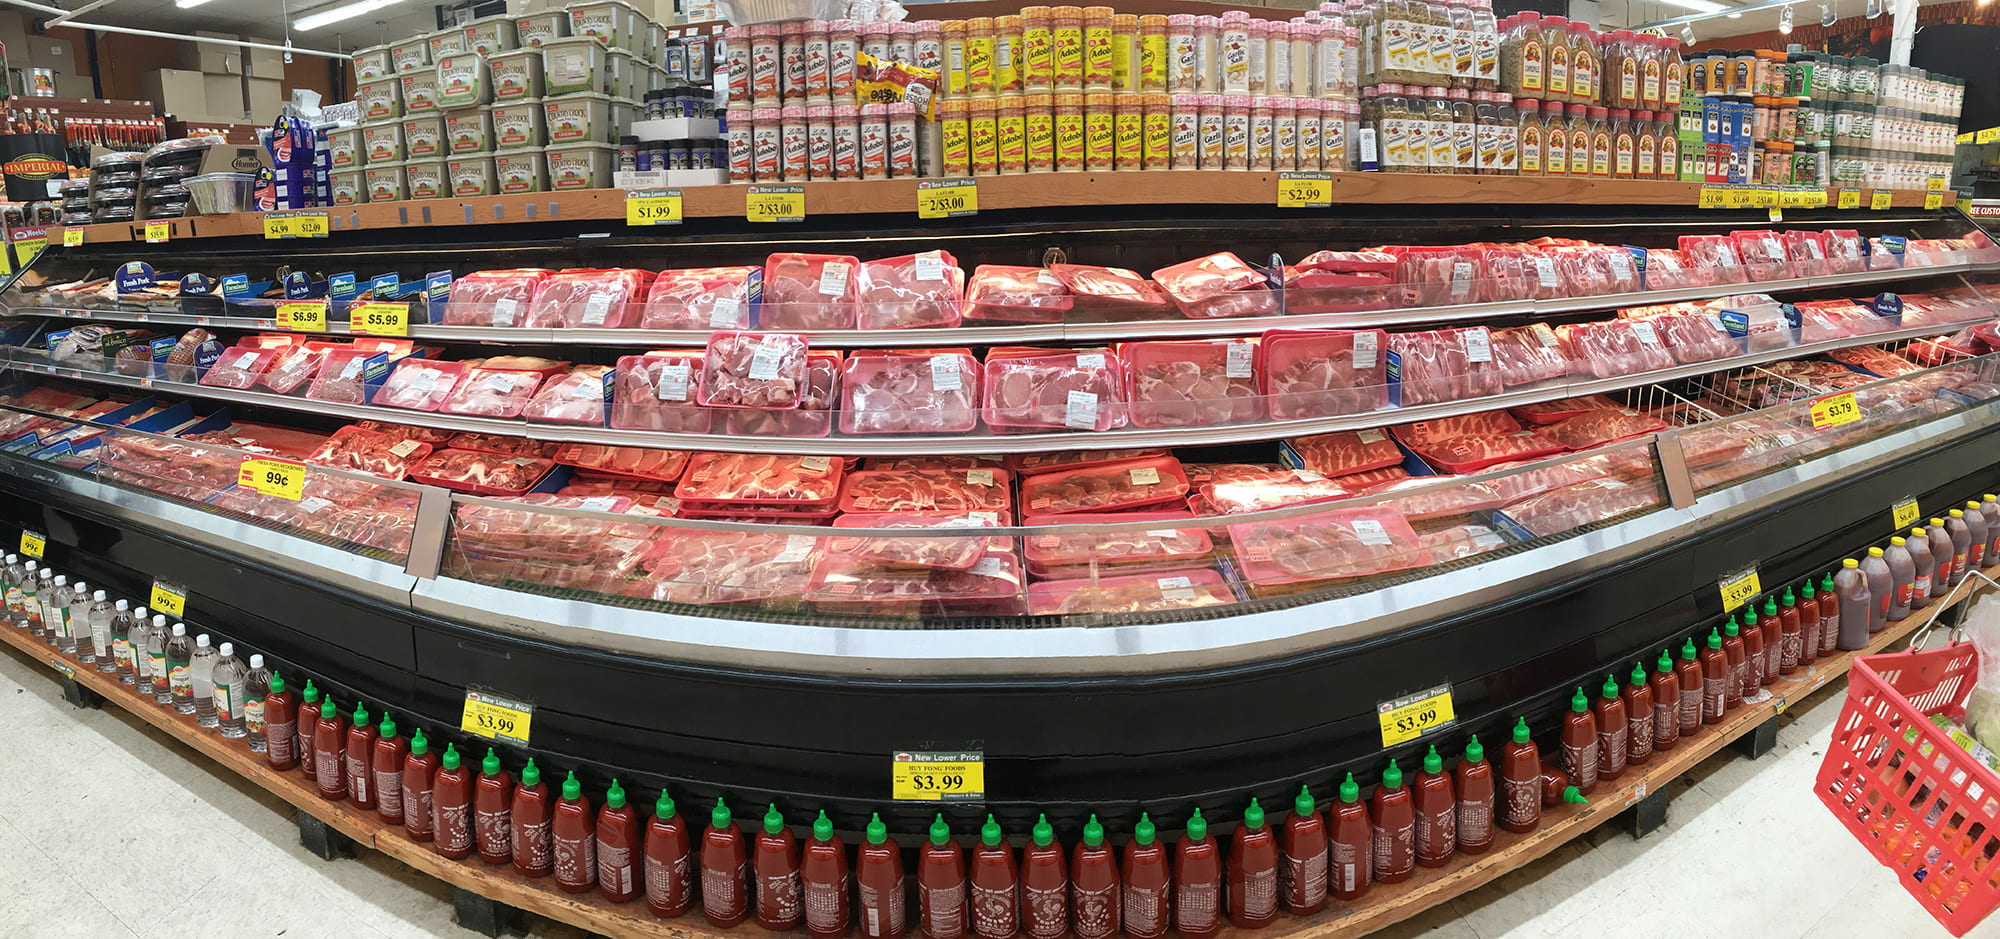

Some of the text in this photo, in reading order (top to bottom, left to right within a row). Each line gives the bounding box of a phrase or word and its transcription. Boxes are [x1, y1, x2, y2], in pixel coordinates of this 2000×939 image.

[10, 163, 61, 172] IMPERIAL
[1288, 188, 1320, 201] $2.99
[1706, 195, 1723, 204] $1.99
[759, 203, 792, 215] 2/$3.00
[930, 197, 964, 211] 2/$3.00
[638, 207, 670, 218] $1.99
[270, 224, 289, 234] $4.99
[123, 277, 150, 288] Fresh Pork
[293, 312, 318, 322] $6.99
[368, 314, 398, 325] $5.99
[1829, 403, 1851, 417] $3.79
[266, 472, 289, 486] 99¢
[24, 541, 39, 553] 99¢
[1731, 584, 1752, 601] $3.99
[157, 596, 176, 609] 99¢
[1411, 693, 1428, 703] Lower
[1431, 687, 1447, 696] Price
[482, 695, 529, 713] New Lower Price
[477, 713, 514, 733] $3.99
[1396, 709, 1436, 733] $3.99
[961, 753, 980, 761] Price
[913, 775, 963, 790] $3.99
